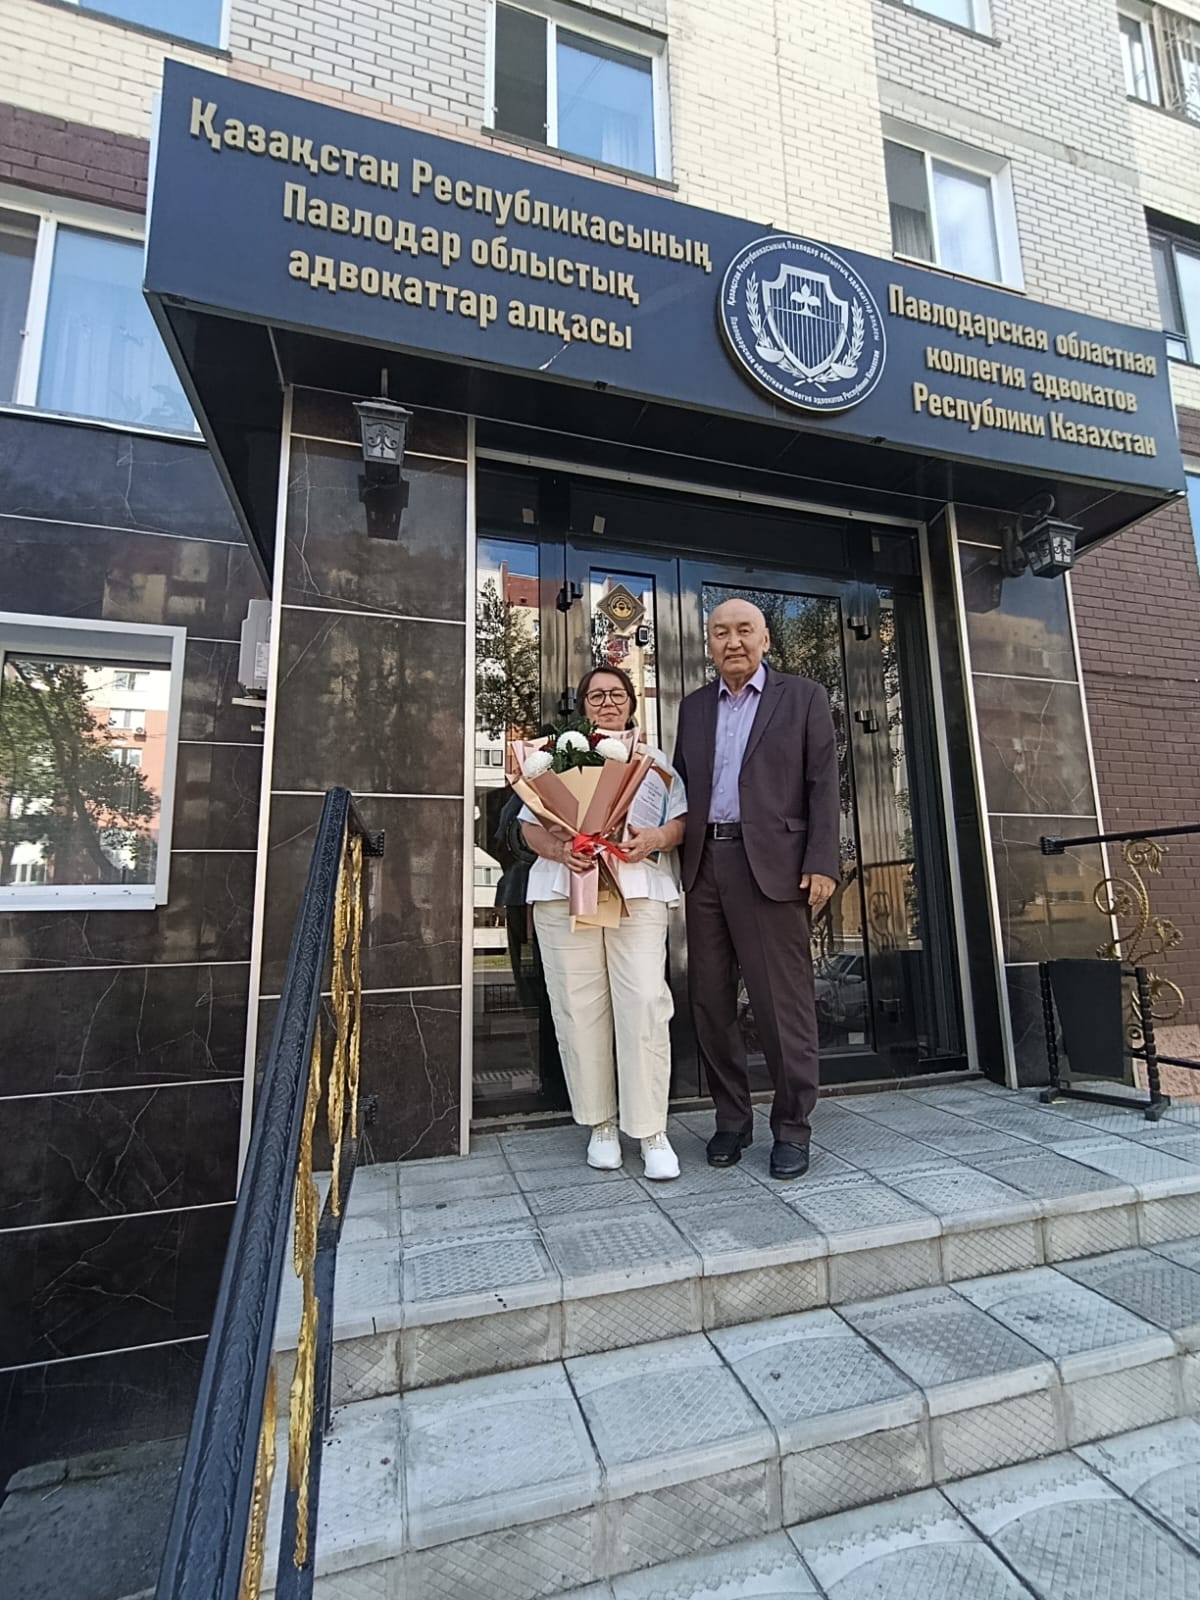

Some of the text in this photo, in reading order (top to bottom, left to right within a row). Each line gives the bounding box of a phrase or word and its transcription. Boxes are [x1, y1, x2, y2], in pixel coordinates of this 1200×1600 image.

[189, 97, 712, 273] Қазақстан Республикасының
[284, 181, 640, 306] Павлодар облыстық
[288, 248, 633, 351] адвокаттар алқасы
[888, 283, 1157, 376] Павлодарская областная
[912, 382, 1157, 457] Республики Казахстан
[926, 346, 1137, 412] коллегия адвокатов
